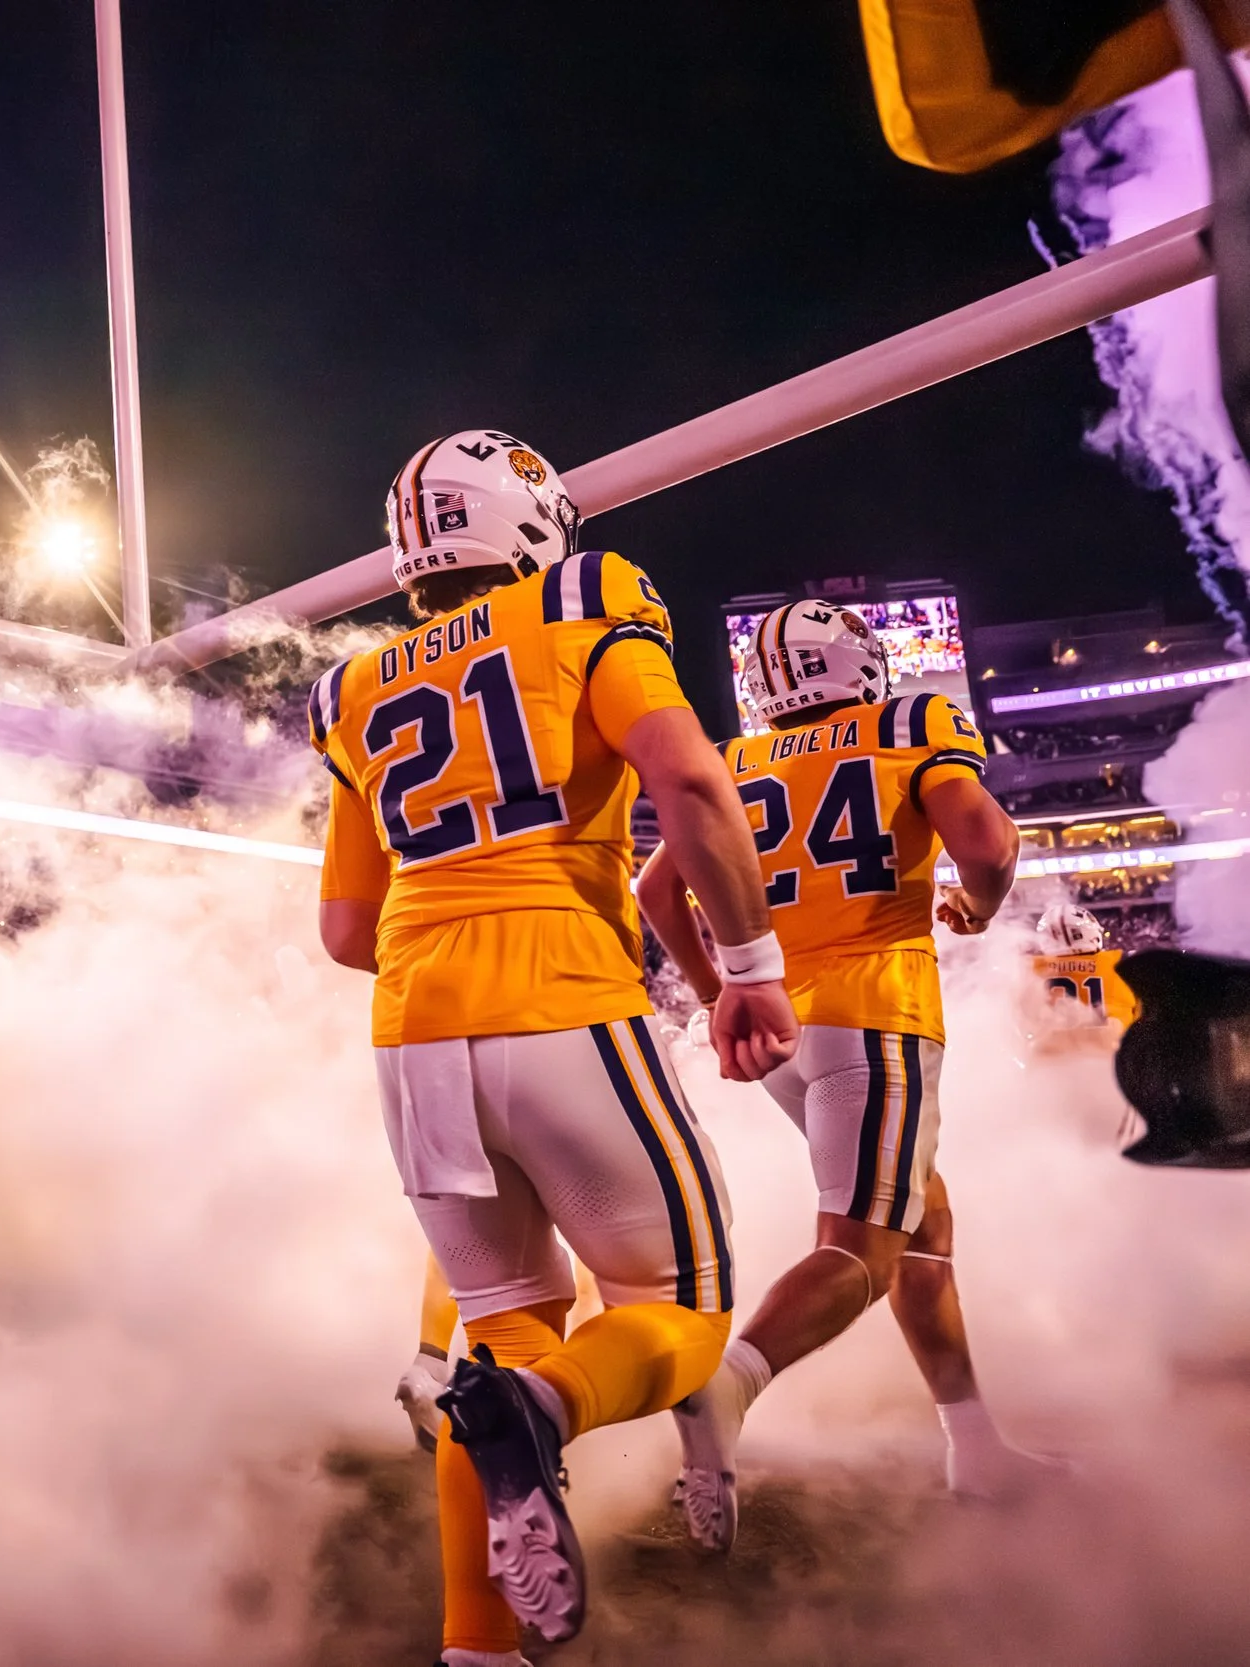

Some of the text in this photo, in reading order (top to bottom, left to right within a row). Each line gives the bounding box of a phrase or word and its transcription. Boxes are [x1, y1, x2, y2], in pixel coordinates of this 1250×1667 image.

[394, 552, 458, 581] TIGERS
[380, 601, 492, 686] DYSON
[762, 691, 824, 716] TIGERS
[1080, 686, 1101, 700] IT
[361, 645, 570, 871] 21
[735, 719, 859, 774] L. IBIETA
[736, 755, 899, 910] 24
